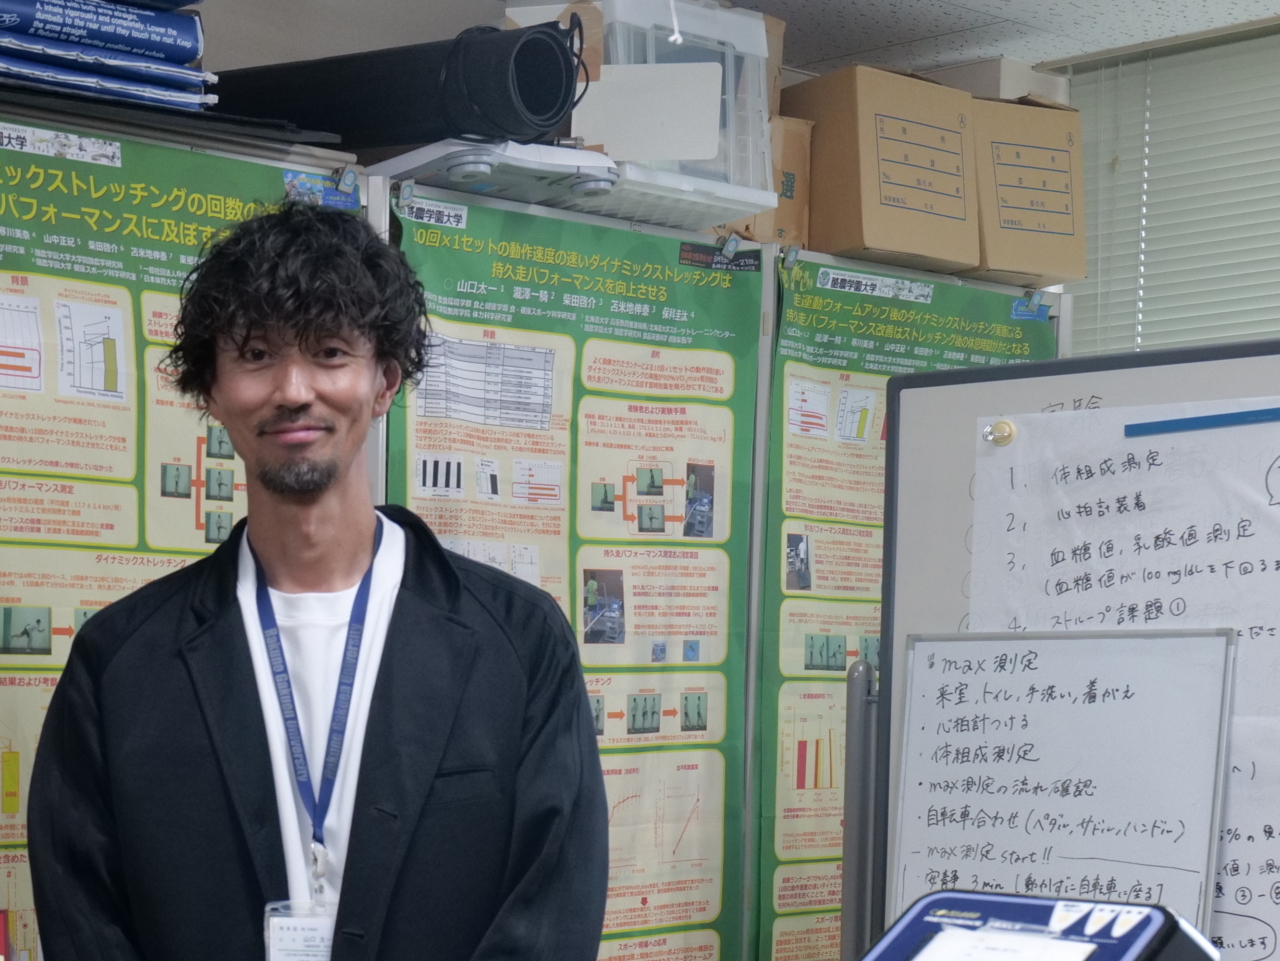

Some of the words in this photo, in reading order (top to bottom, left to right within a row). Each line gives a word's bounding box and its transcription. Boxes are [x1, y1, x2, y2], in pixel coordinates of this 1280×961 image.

[65, 9, 97, 21] vigorously
[99, 15, 110, 23] and
[147, 23, 166, 34] Lower
[65, 17, 72, 25] to
[74, 19, 84, 27] the
[101, 23, 115, 32] until
[117, 27, 129, 37] they
[132, 30, 149, 39] touch
[177, 38, 192, 48] Keep
[11, 275, 29, 286] 背景
[491, 261, 667, 302] 持久走パフォーマンスを向上させる
[830, 275, 877, 293] 酪農学園大学
[483, 330, 496, 339] 背景
[1052, 450, 1163, 485] 体組成測定
[1057, 492, 1146, 522] 心拍計装着
[264, 628, 283, 674] Rakuno
[285, 719, 309, 782] University
[937, 714, 1029, 735] 心拍計つける
[931, 742, 1040, 765] 体組成測定
[929, 776, 1097, 798] max測定の流れ確認
